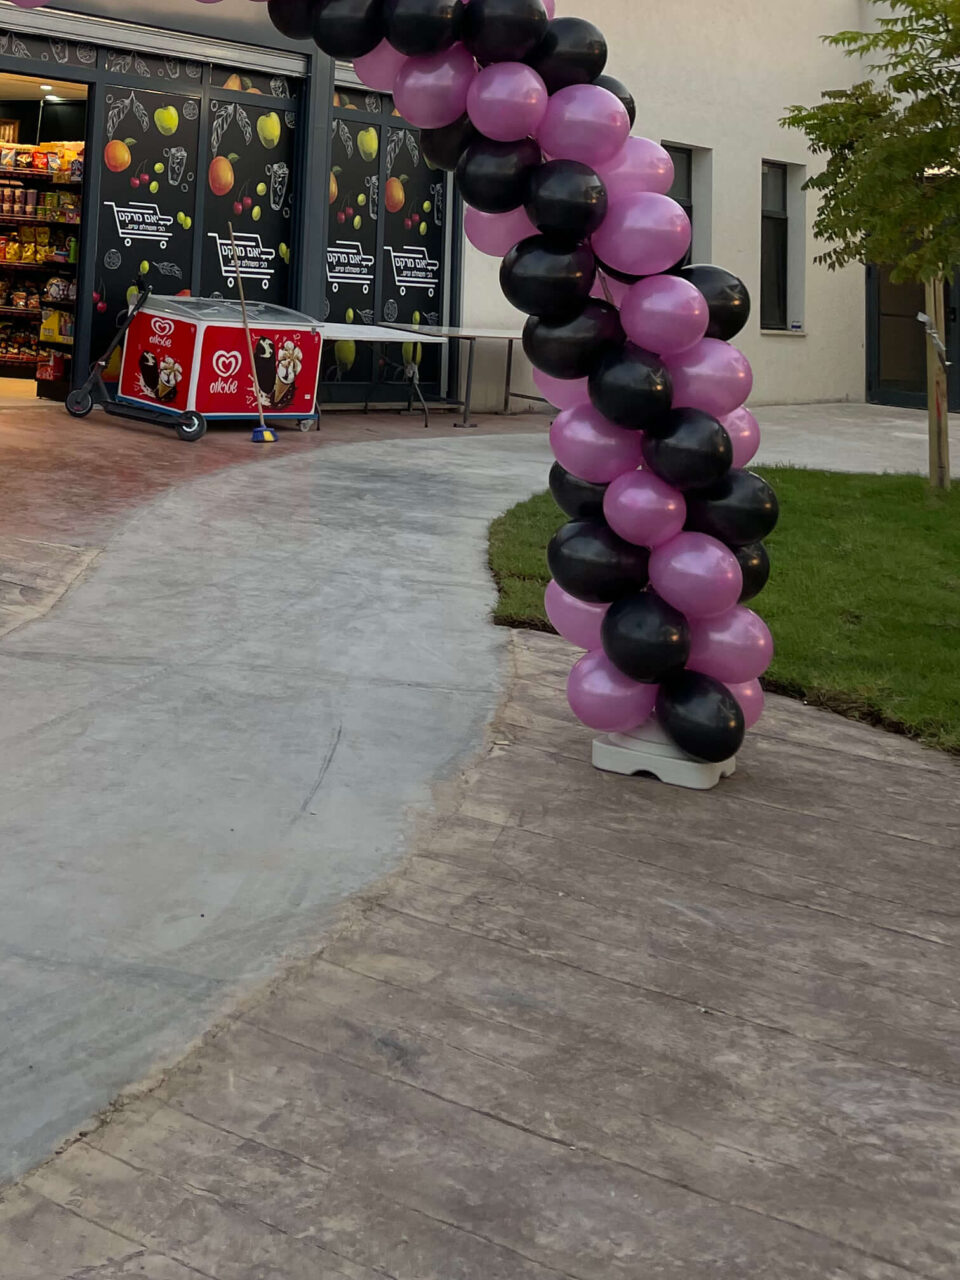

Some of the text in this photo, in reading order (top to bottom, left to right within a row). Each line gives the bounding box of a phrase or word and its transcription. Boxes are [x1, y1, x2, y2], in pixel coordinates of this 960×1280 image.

[118, 212, 159, 223] יאם מרקט
[246, 247, 261, 257] יאם
[327, 253, 361, 265] יאם מרקט
[395, 258, 427, 269] יאם מרקט
[210, 376, 238, 393] שטראוס
